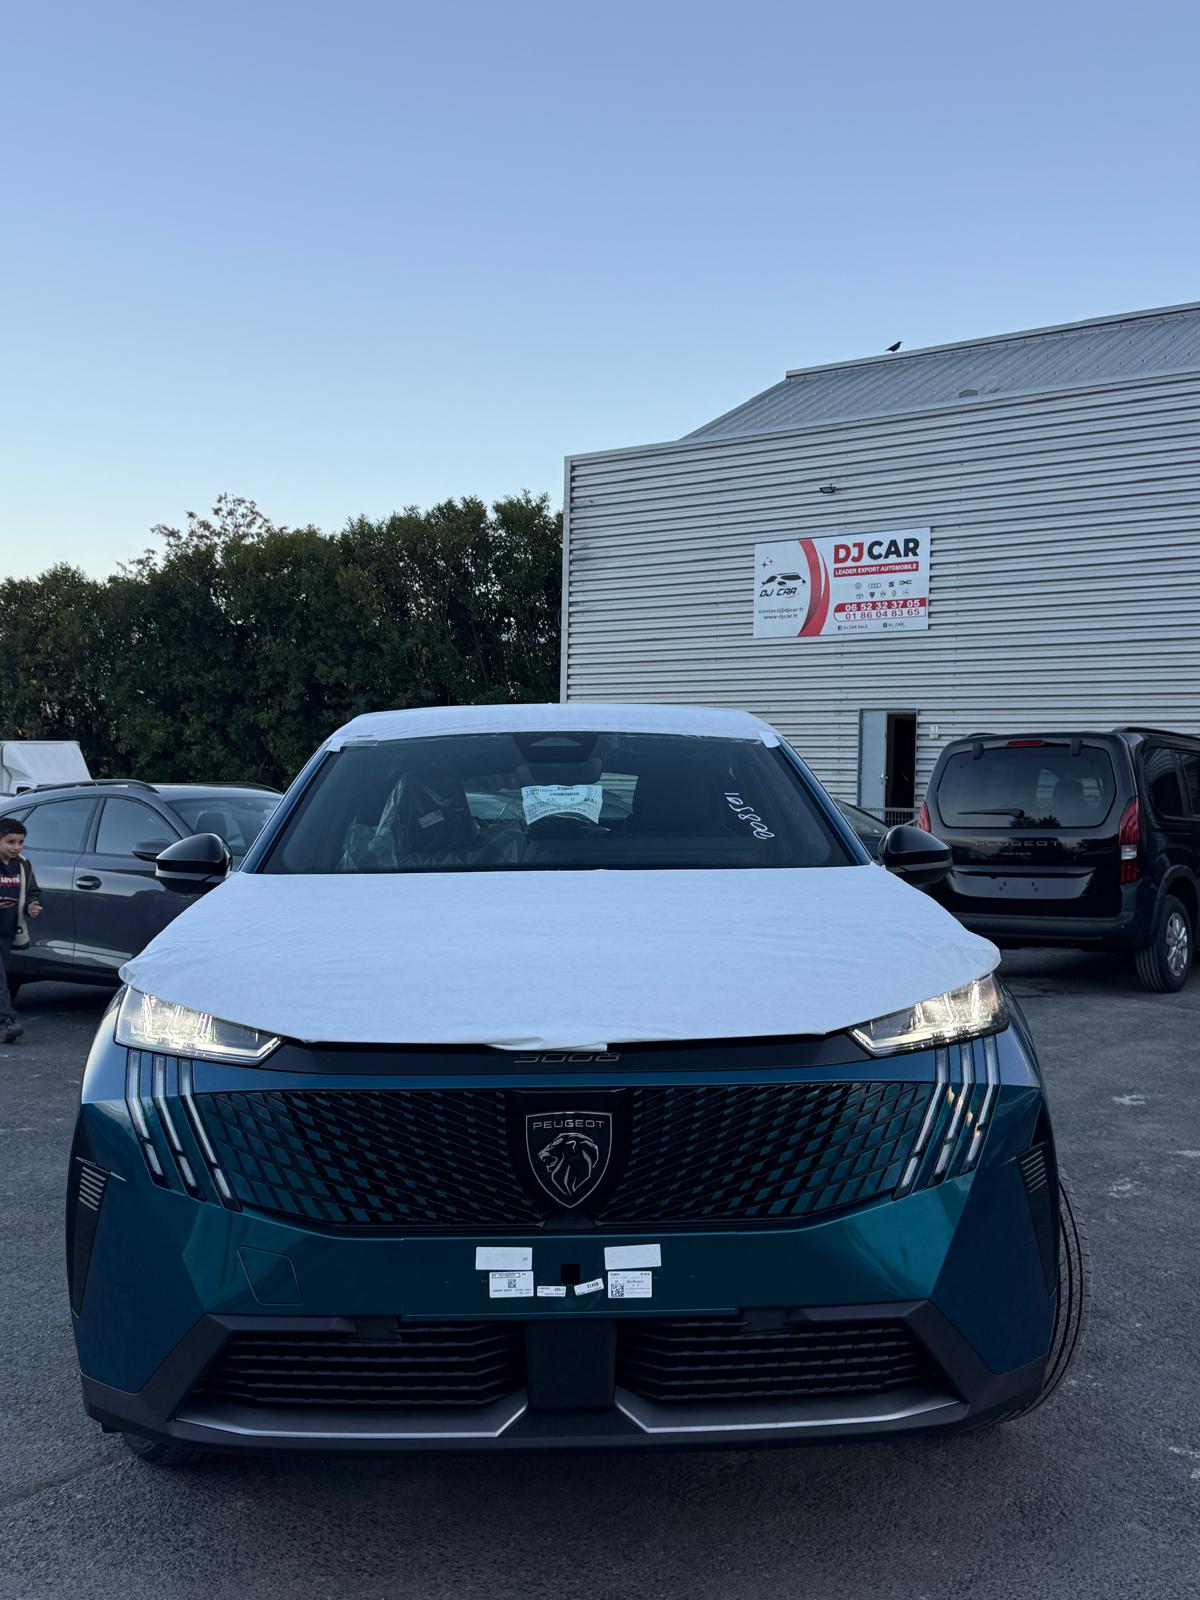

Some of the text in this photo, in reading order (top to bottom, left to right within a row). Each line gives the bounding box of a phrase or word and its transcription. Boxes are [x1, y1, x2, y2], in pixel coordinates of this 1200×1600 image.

[835, 563, 917, 576] LEADER EXPORT AUTOMOBILE
[759, 587, 797, 597] DJ CAR
[845, 608, 920, 620] 01 86 04 83 65
[514, 1052, 621, 1064] 3008
[533, 1119, 604, 1130] PEUGEOT
